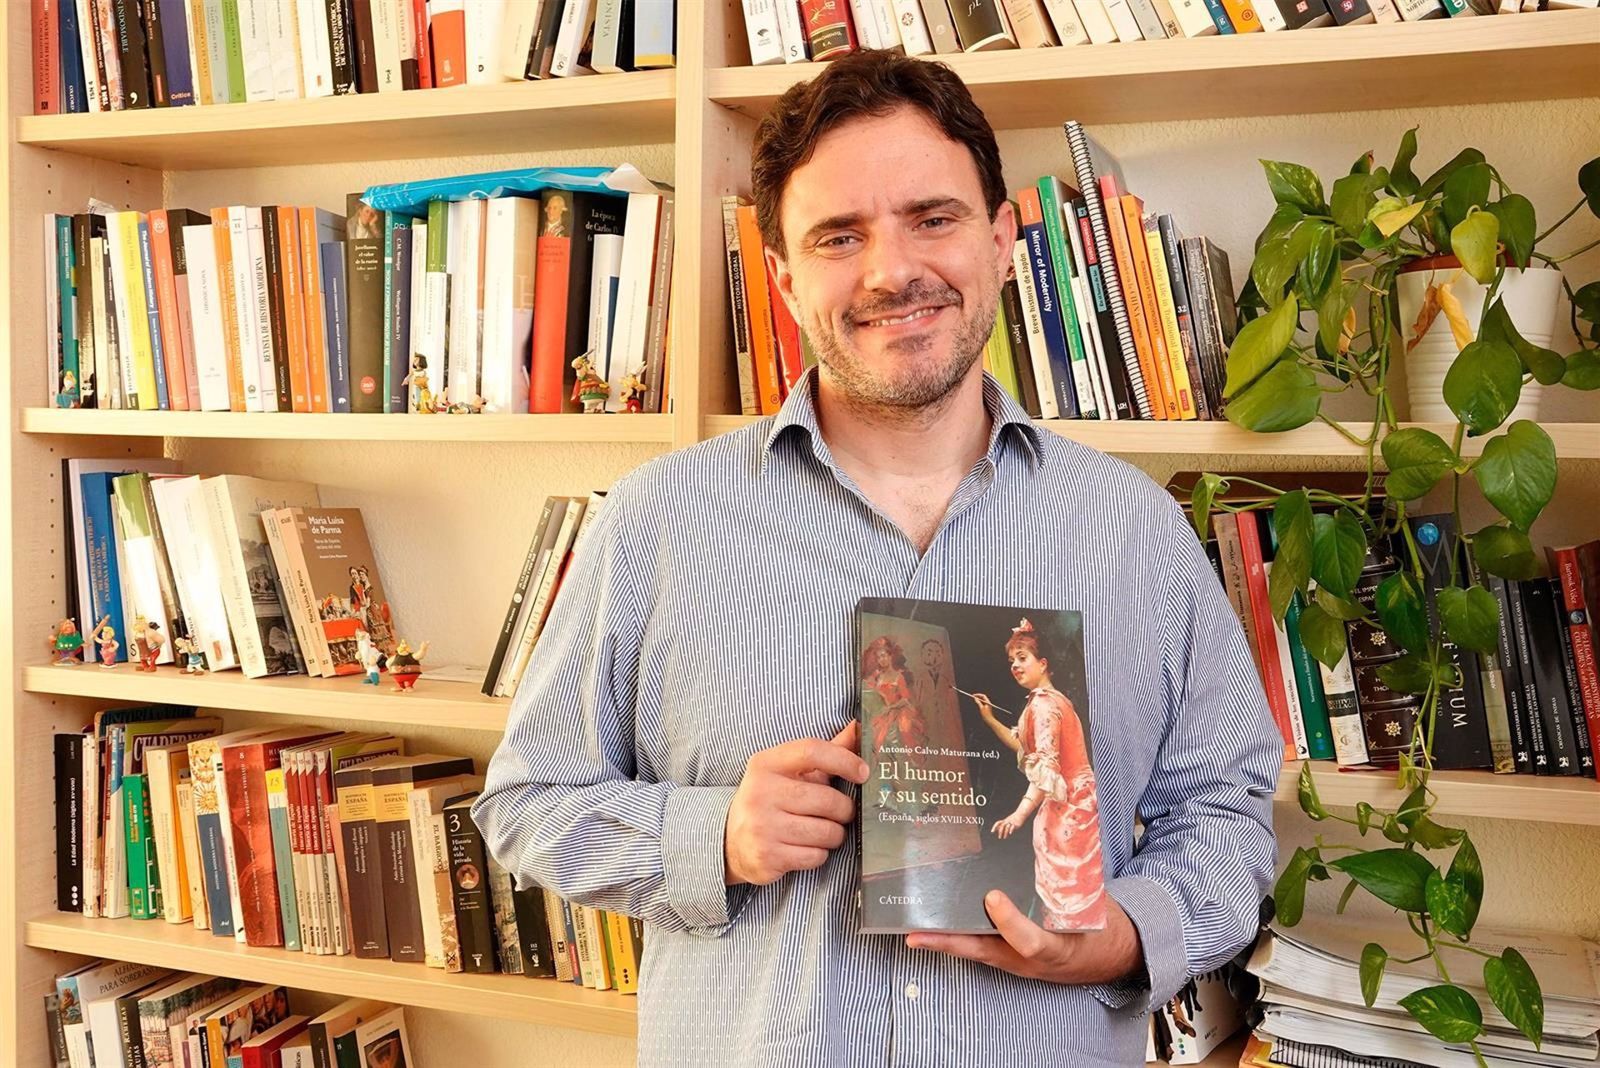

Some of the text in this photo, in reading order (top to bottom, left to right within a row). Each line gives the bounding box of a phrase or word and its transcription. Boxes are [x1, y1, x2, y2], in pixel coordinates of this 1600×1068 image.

[116, 5, 129, 53] INDOMABLE
[328, 1, 341, 67] IMAGEN HISTÓRICA
[68, 84, 76, 111] OXFORD
[590, 208, 600, 218] La
[584, 220, 593, 230] de
[592, 222, 612, 233] Carlos
[142, 240, 150, 261] Journal
[145, 267, 153, 289] Modern
[1030, 229, 1054, 313] Mirror of Modernity
[731, 255, 742, 310] HISTORIA GLOBAL
[147, 288, 155, 308] History
[1018, 252, 1040, 334] Breve historia de Japón
[254, 255, 271, 363] REVISTA DE HISTORIA MODERNA
[1128, 289, 1141, 318] CHINA
[1010, 322, 1025, 344] Japón
[1154, 327, 1160, 335] LA
[1163, 308, 1178, 348] Traditional
[1059, 380, 1069, 409] CALIFORNIA
[306, 515, 345, 525] María Luisa
[310, 524, 342, 535] de Parma
[295, 569, 304, 587] Parma
[302, 593, 311, 608] Luisa
[1514, 600, 1522, 616] CASAS
[305, 607, 315, 624] María
[1498, 611, 1504, 619] LA
[1499, 618, 1505, 626] DE
[1500, 625, 1510, 654] GARCILASO
[1518, 626, 1524, 634] DE
[129, 643, 136, 656] S
[1519, 633, 1529, 664] BARTOLOMÉ
[1573, 630, 1586, 668] COLUMBUS
[1582, 683, 1595, 720] AMERICAS
[1286, 678, 1295, 703] vencidos
[1524, 684, 1530, 692] LA
[1510, 690, 1523, 745] COMENTARIOS REALES
[1572, 706, 1578, 715] LA
[1294, 722, 1302, 740] Visión
[1550, 696, 1564, 750] CRÓNICAS DE INDIAS
[1575, 724, 1585, 749] HISTORIA
[879, 746, 1000, 759] Antonio Calvo Maturana (ed.)
[879, 762, 965, 783] El humor
[344, 796, 368, 804] ESPAÑA
[383, 795, 406, 803] ESPAÑA
[879, 788, 987, 808] y su sentido
[288, 802, 296, 821] España
[309, 804, 317, 823] España
[878, 812, 984, 826] (España, siglos XVIII-XXI)
[302, 804, 312, 850] Historia de España
[311, 823, 317, 831] de
[449, 813, 461, 832] 3
[290, 828, 298, 848] Historia
[297, 830, 305, 850] Historia
[432, 823, 443, 870] EL BARROCO
[71, 858, 76, 866] La
[453, 855, 472, 865] privada
[879, 894, 922, 904] CÁTEDRA
[118, 1006, 131, 1043] RAMERAS
